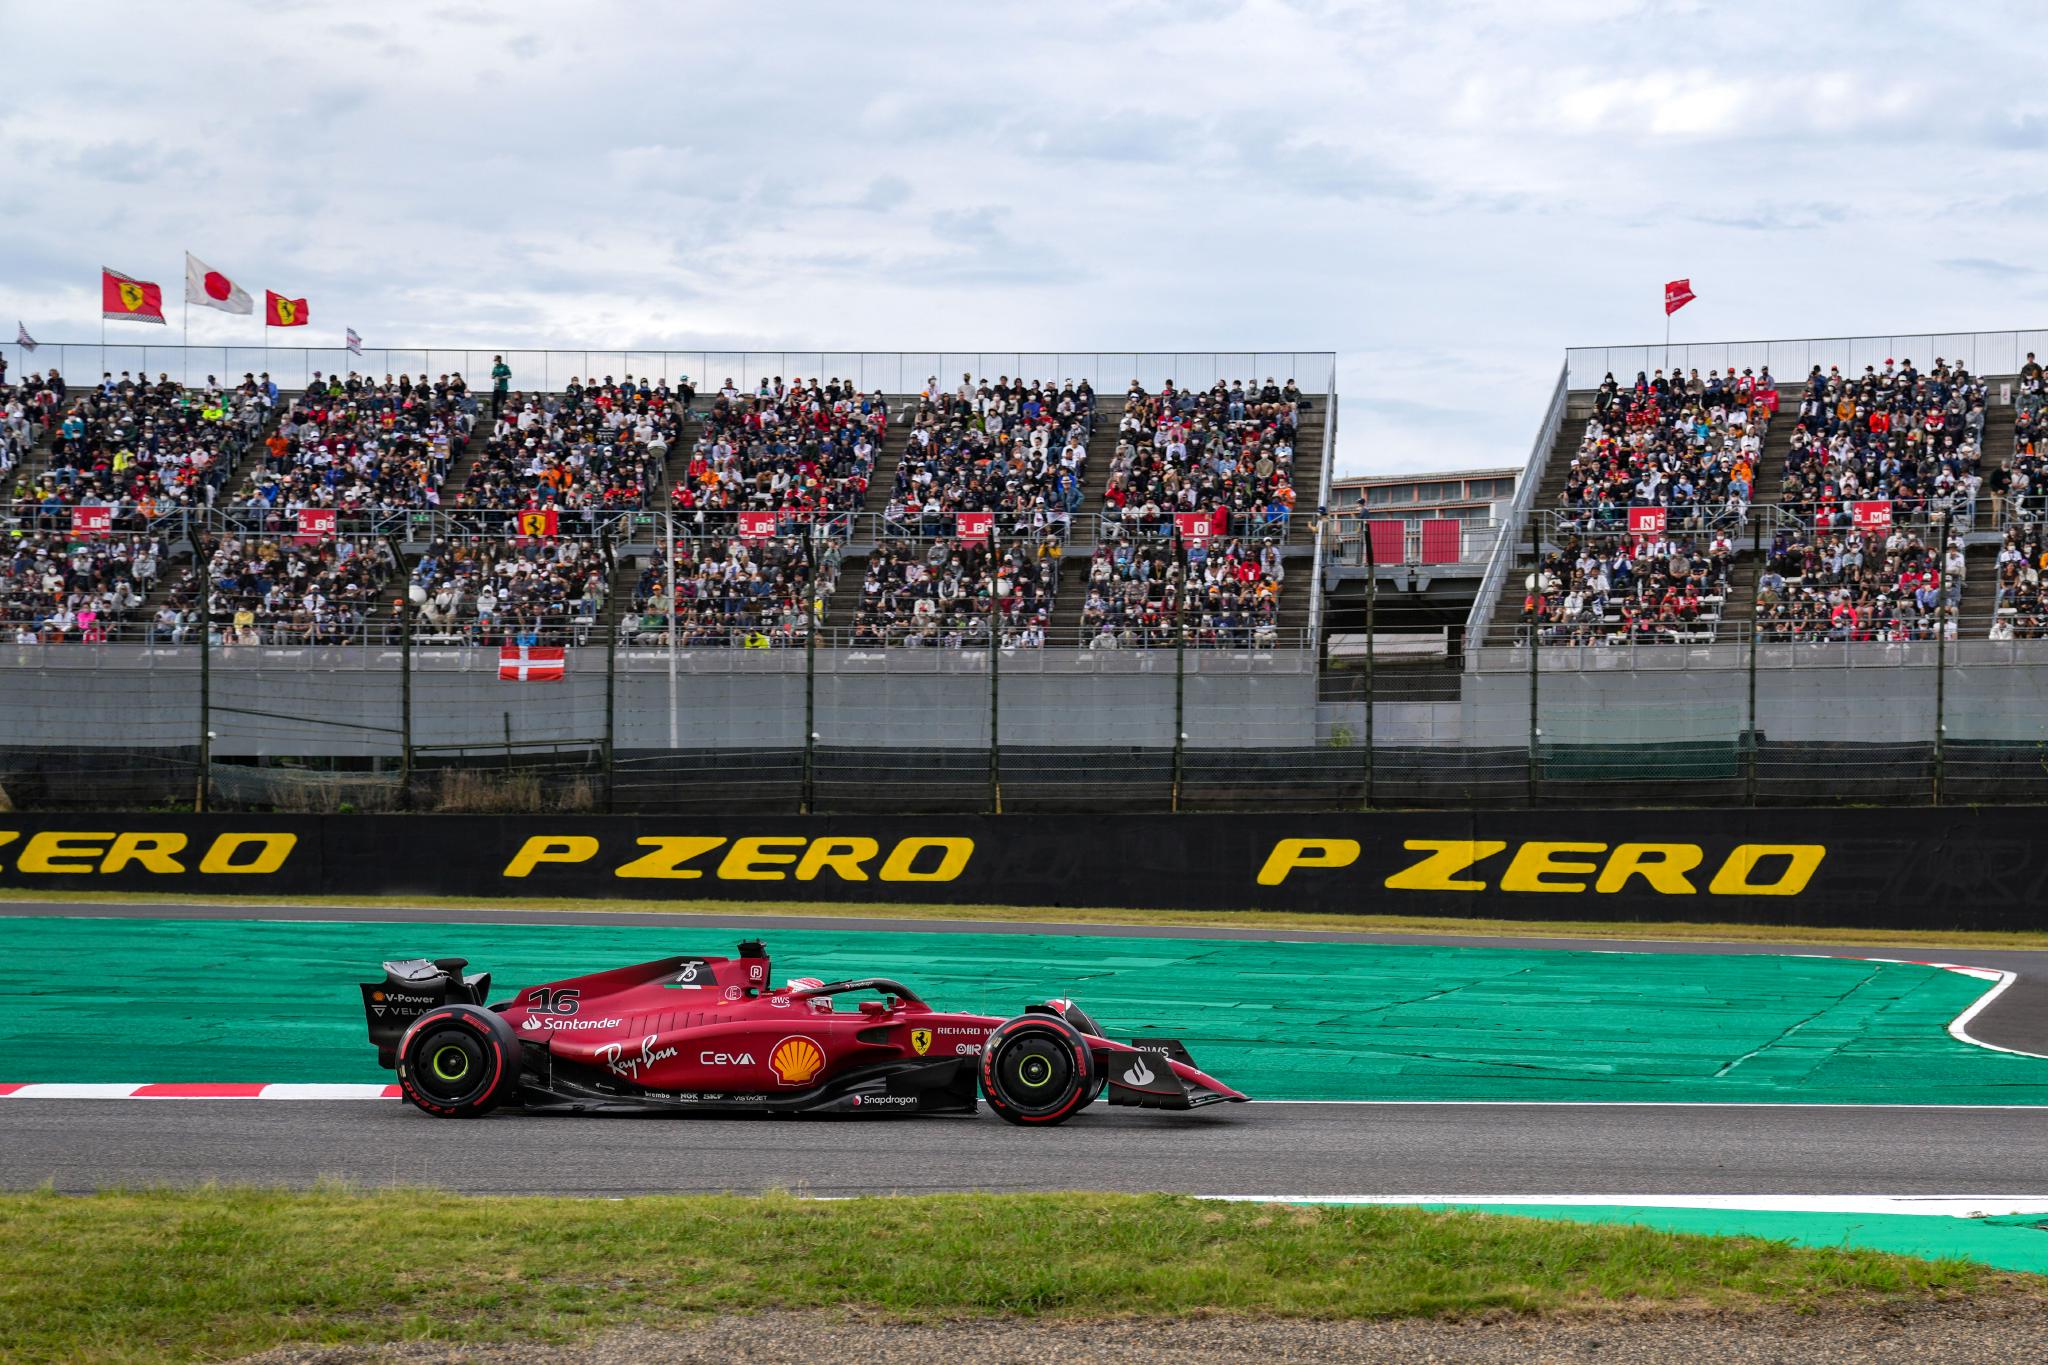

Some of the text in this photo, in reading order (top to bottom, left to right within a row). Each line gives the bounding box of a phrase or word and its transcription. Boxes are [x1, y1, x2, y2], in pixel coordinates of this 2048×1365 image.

[0, 832, 298, 874] ERO
[503, 835, 975, 882] P ZERO
[1256, 838, 1361, 886] P
[1384, 839, 1826, 896] ZERO
[385, 993, 435, 1003] V-Power
[526, 987, 580, 1016] 16
[771, 996, 790, 1004] aws
[544, 1017, 623, 1030] Santander
[937, 1027, 981, 1035] RICHARD
[644, 1090, 671, 1099] brembo
[863, 1094, 918, 1106] Snapdragon
